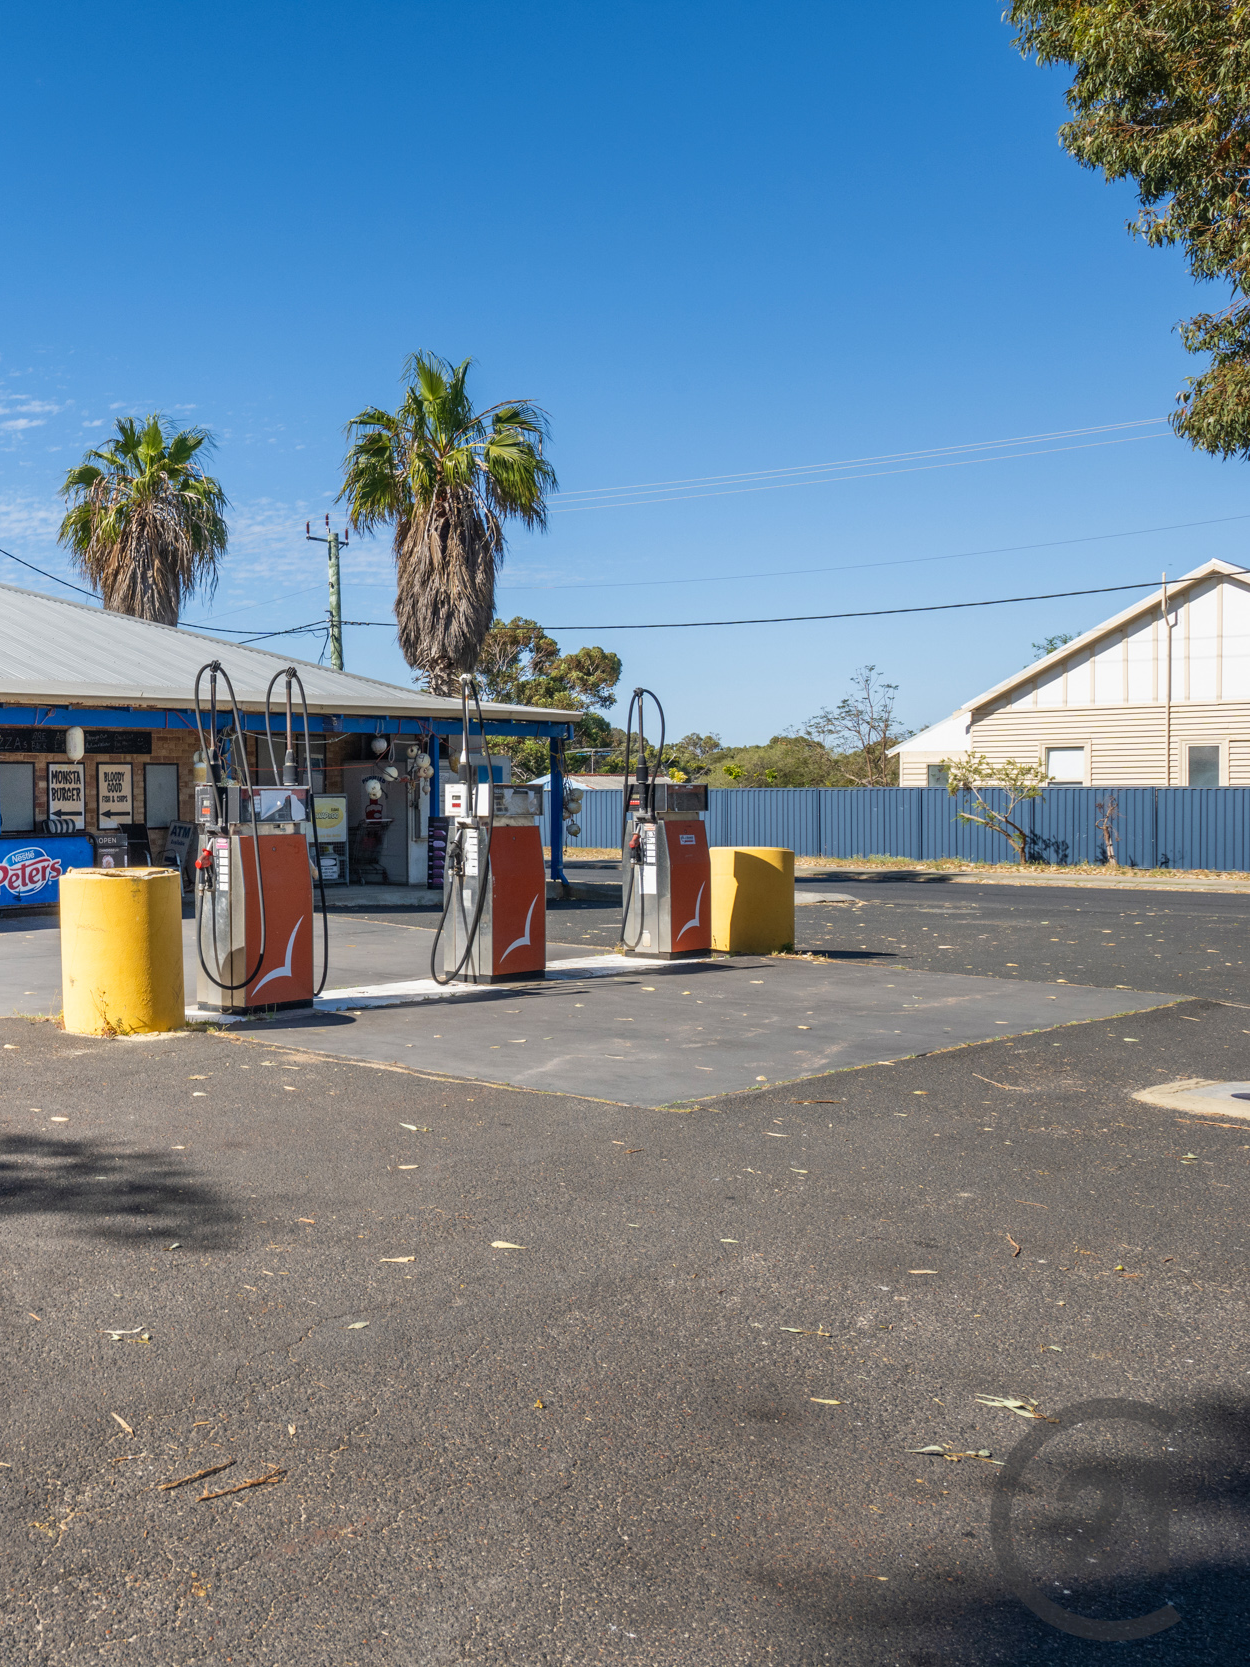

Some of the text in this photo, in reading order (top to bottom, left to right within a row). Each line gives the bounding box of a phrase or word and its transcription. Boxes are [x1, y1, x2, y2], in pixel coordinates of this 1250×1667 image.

[51, 770, 81, 785] MONSTA
[104, 772, 125, 782] BLOODY
[362, 776, 386, 785] PURIFIED
[107, 783, 122, 793] GOOD
[51, 787, 81, 802] BURGER
[117, 795, 128, 803] CHIPS
[170, 826, 191, 838] ATM
